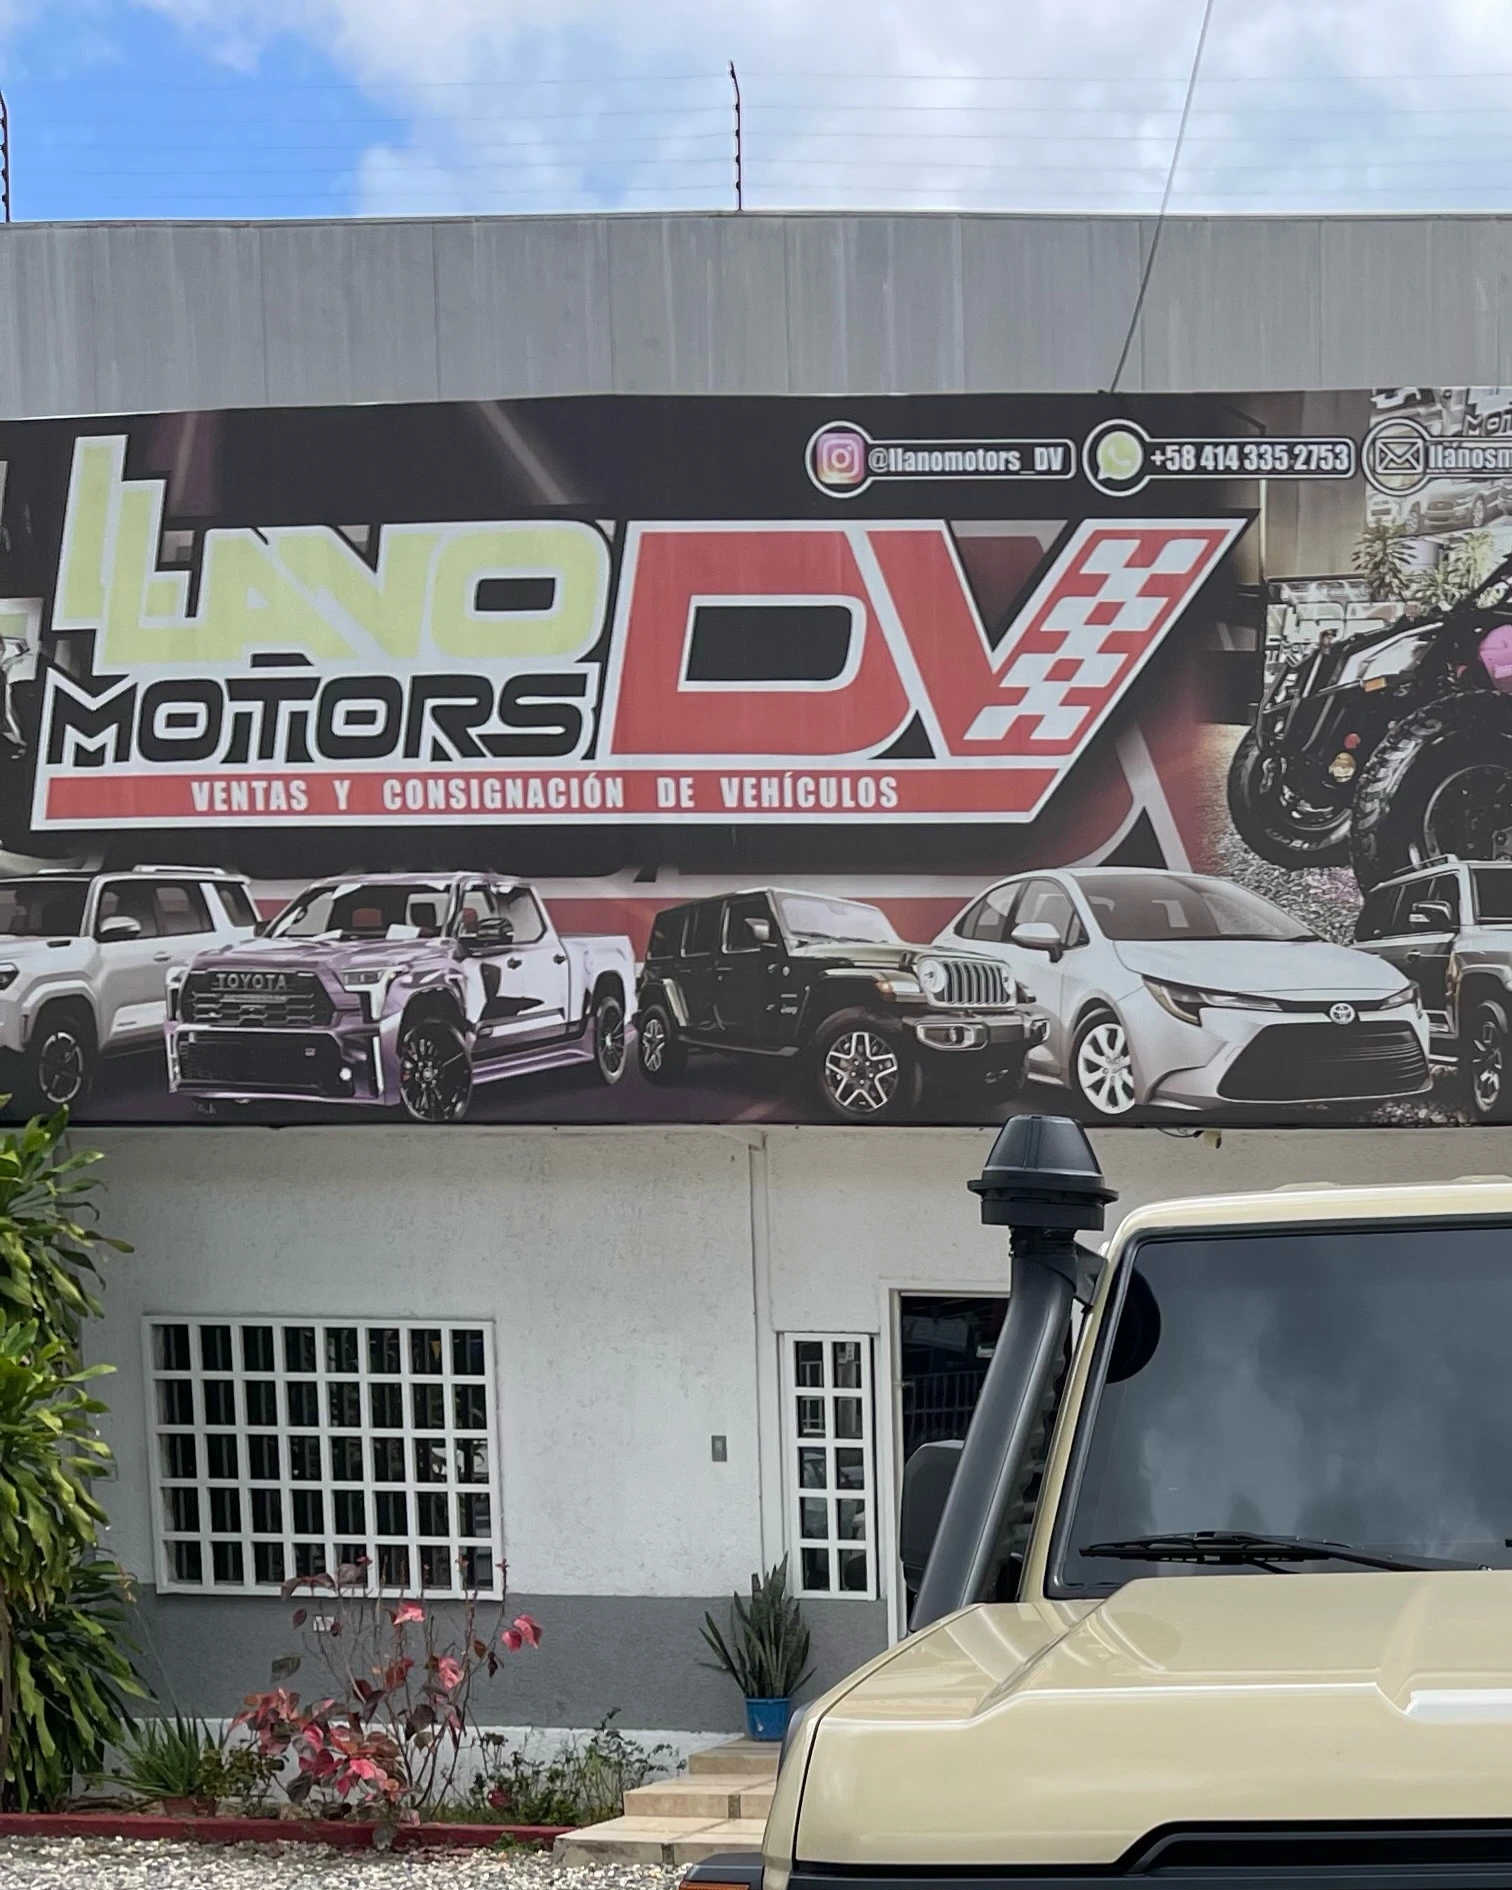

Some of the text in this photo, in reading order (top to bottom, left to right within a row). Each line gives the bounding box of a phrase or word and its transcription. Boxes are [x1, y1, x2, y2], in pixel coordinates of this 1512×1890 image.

[868, 446, 1064, 474] @llanomotors_DV
[1150, 444, 1350, 471] +58 414 335 2753
[52, 436, 606, 668] LLANO
[608, 522, 1238, 762] DV
[46, 672, 594, 766] MOTORS
[190, 771, 899, 811] VENTAS Y CONSIGNACIÓN DE VEHÍCULOS
[216, 973, 288, 991] TOYOTA
